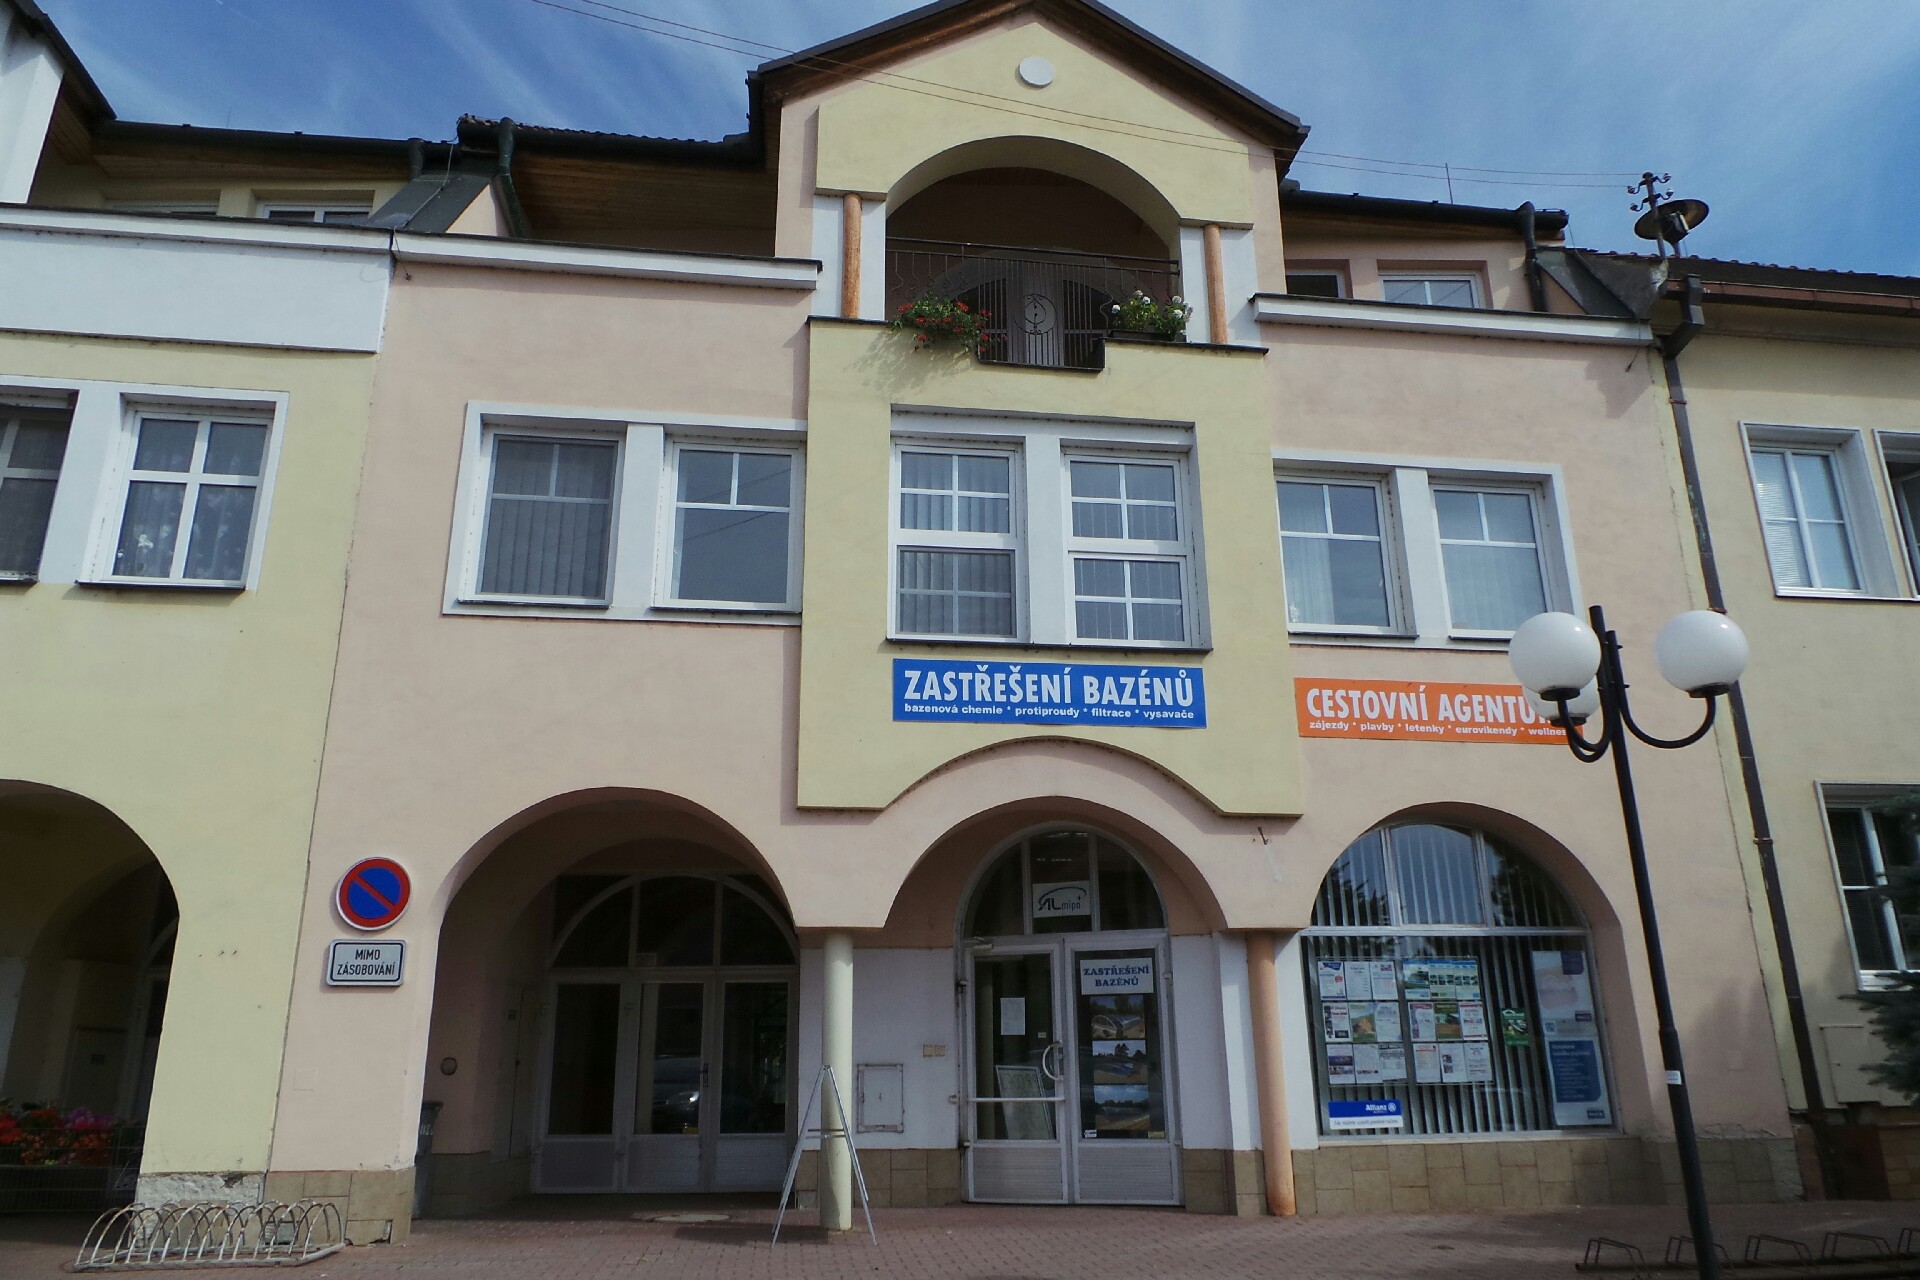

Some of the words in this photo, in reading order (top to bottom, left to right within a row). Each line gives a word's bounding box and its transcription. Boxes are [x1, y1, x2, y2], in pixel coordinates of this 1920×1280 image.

[904, 664, 1072, 704] ZASTŘEŠENÍ
[1083, 669, 1194, 707] BAZÉNŮ
[904, 703, 958, 714] bazenová
[961, 704, 1003, 715] chemie
[1015, 705, 1080, 717] protiproudy
[1091, 707, 1132, 718] filtrace
[1143, 709, 1195, 720] vysavače
[1306, 685, 1429, 721] CESTOVNÍ
[1438, 693, 1552, 725] AGENTU
[1309, 720, 1350, 731] zájezdy
[1360, 722, 1395, 733] plavby
[1405, 723, 1445, 735] letenky
[1455, 725, 1518, 737] eurovikendy
[1528, 726, 1567, 736] wellnes
[355, 949, 380, 960] MIMO
[337, 962, 395, 975] ZÁSOBOVÁNÍ
[1083, 964, 1149, 976] ZASTŘEŠENÍ
[1095, 975, 1139, 987] BAZÉNŮ
